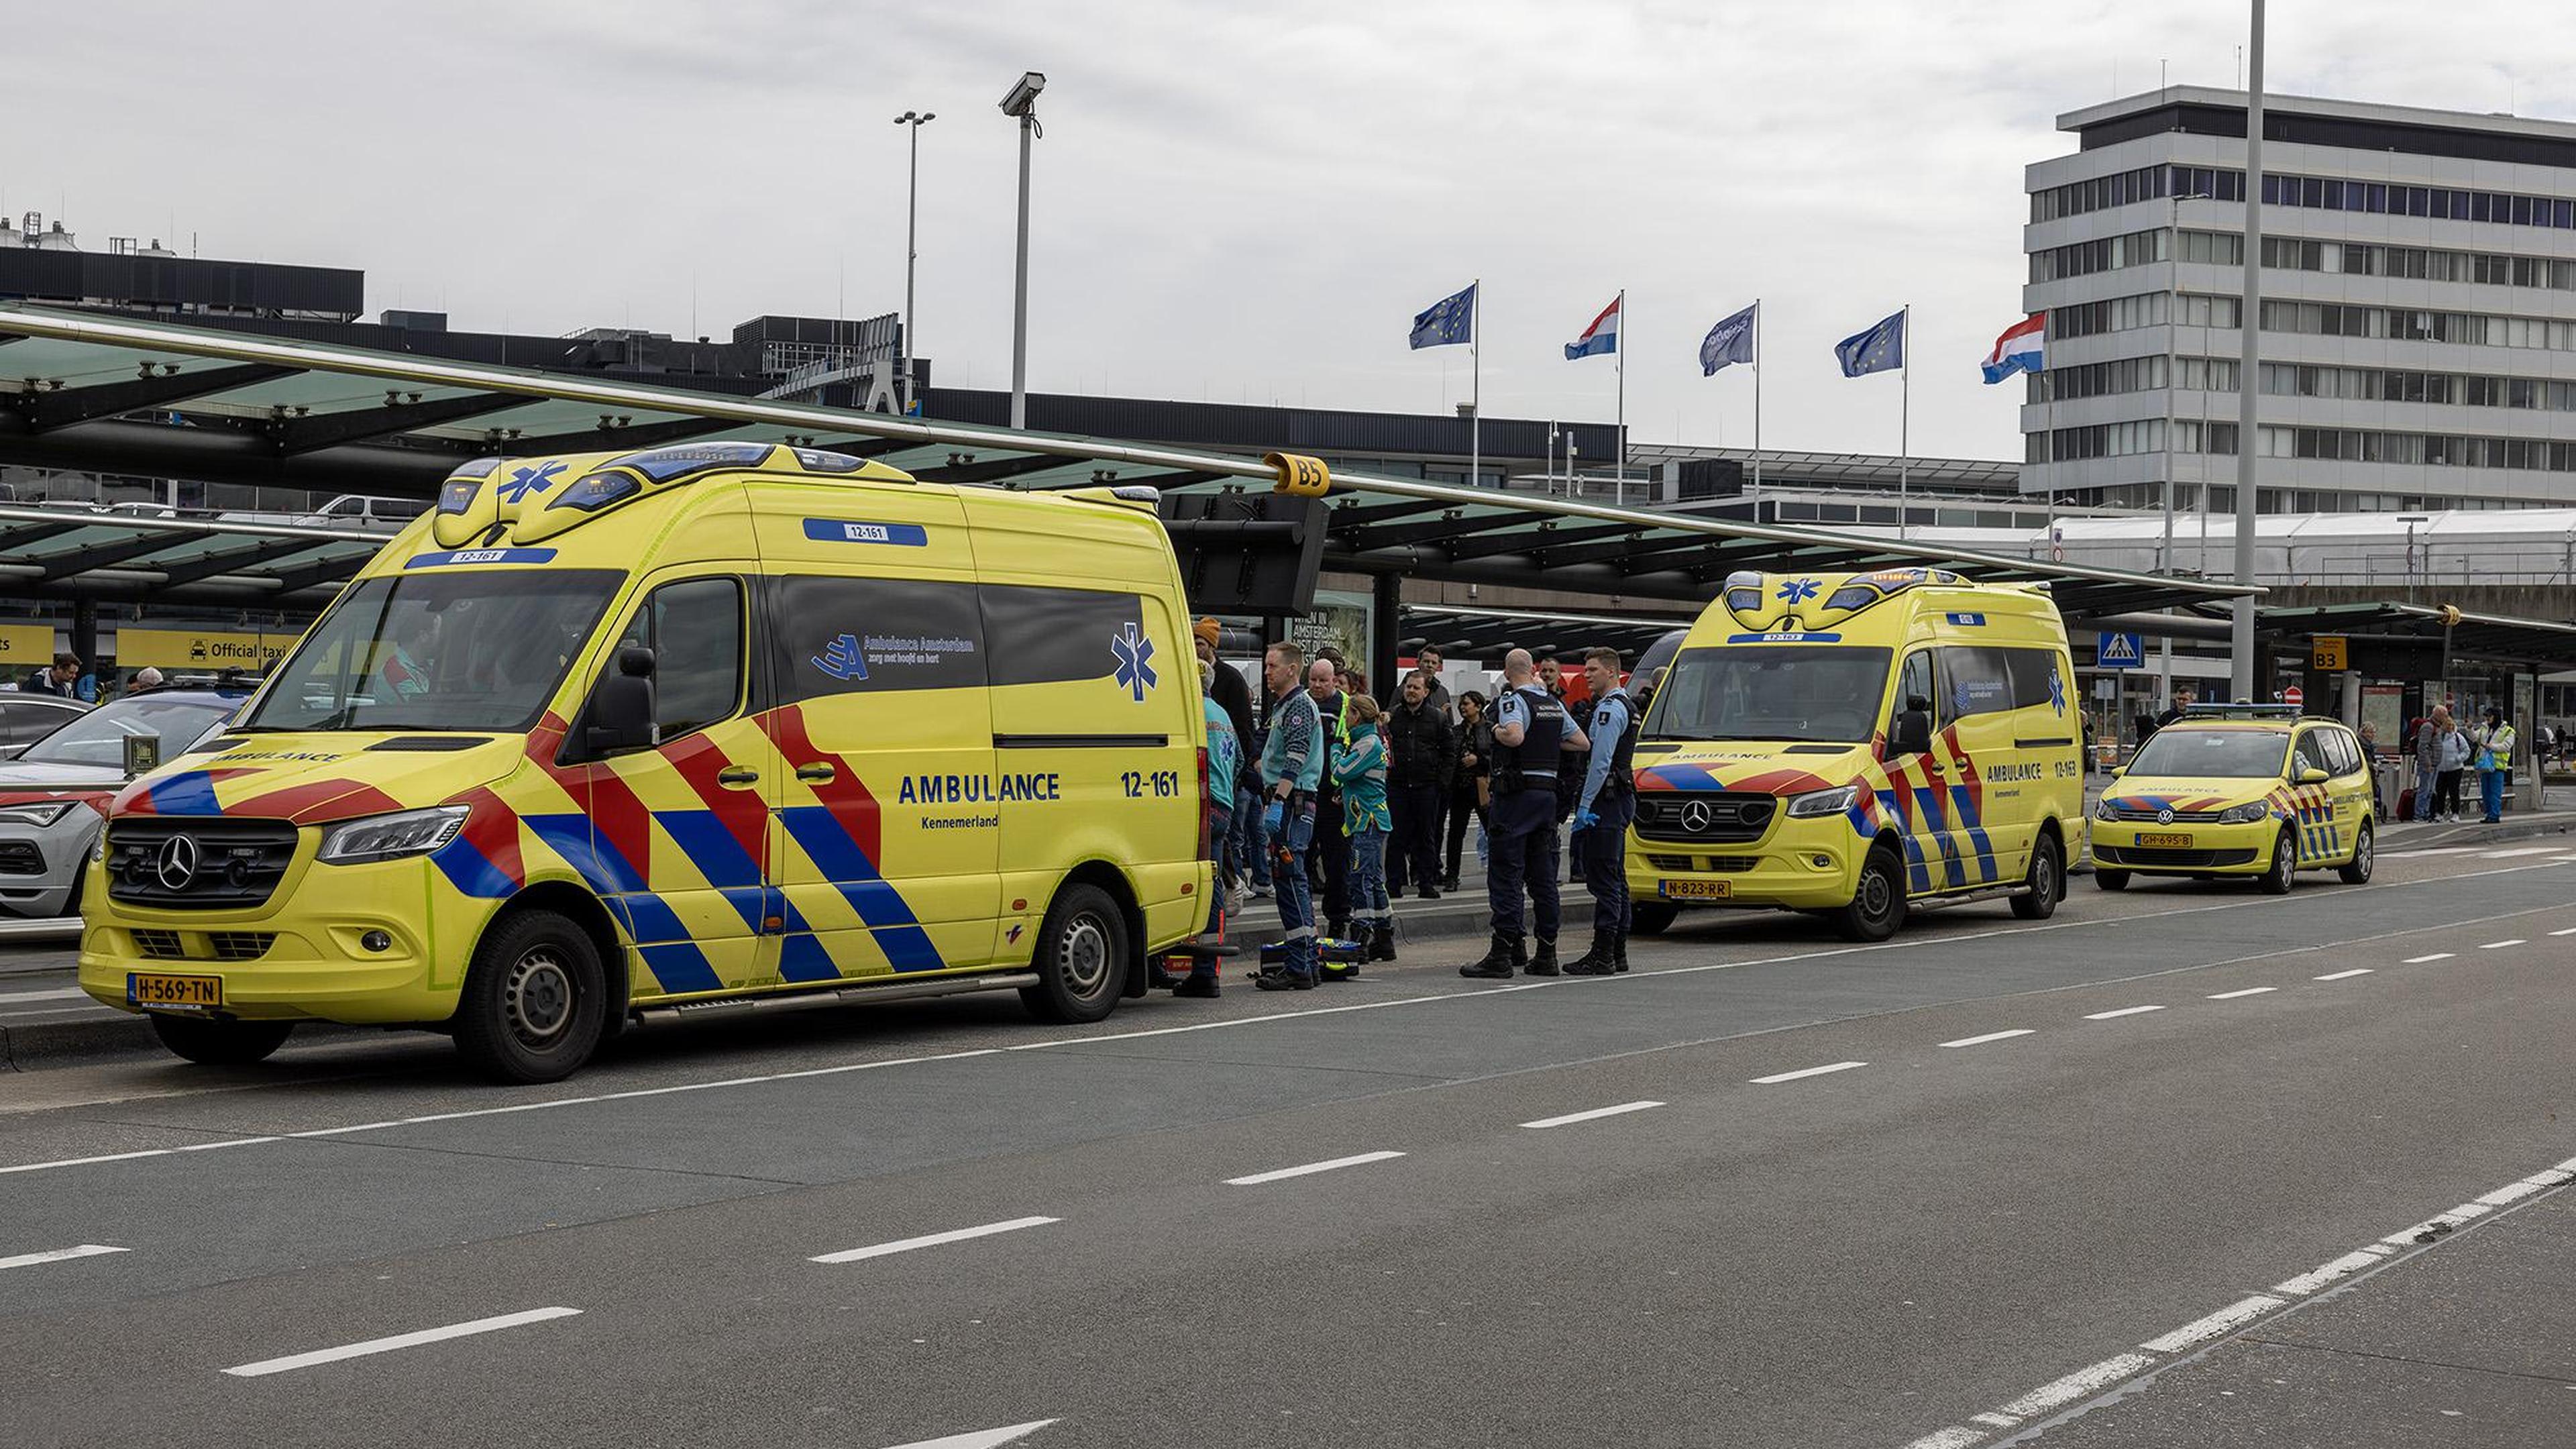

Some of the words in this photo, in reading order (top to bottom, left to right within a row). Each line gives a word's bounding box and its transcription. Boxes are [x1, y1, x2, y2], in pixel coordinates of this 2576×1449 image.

[1297, 460, 1322, 486] B5
[851, 526, 883, 539] 12-161
[460, 552, 498, 561] 12-161
[211, 643, 258, 658] Official
[263, 645, 286, 659] taxi
[864, 635, 919, 651] Ambulance
[920, 637, 974, 652] Amsterdam
[2316, 653, 2336, 667] B3
[212, 752, 342, 762] AMBULANCE
[1987, 763, 2041, 783] AMBULANCE
[2055, 760, 2076, 777] 12-163
[898, 773, 1060, 804] AMBULANCE
[1121, 770, 1179, 798] 12-161
[921, 814, 998, 829] Kennemerland
[1669, 882, 1725, 895] N-823-RR
[139, 979, 214, 1001] H-569-TN
